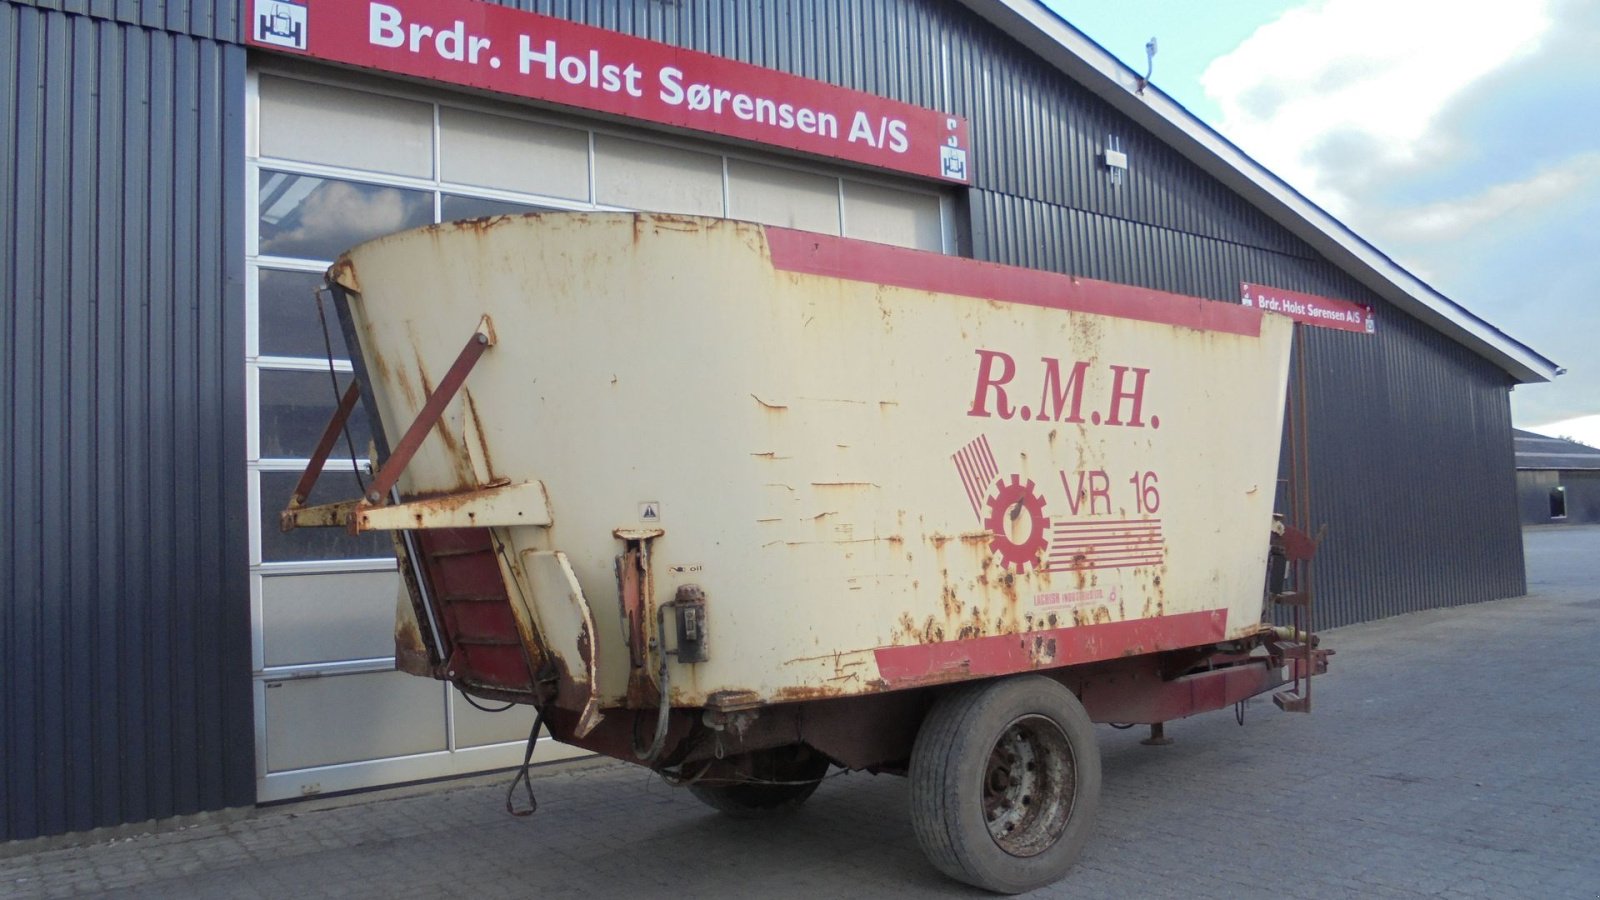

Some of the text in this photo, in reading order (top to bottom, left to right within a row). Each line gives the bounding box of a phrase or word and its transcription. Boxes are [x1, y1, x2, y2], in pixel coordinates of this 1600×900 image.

[369, 2, 908, 153] Brdr. Holst Sørensen A/S
[1258, 295, 1360, 324] Brdr. Holst Sørensen A/S
[967, 349, 1160, 429] R.M.H.
[1059, 470, 1160, 515] VR 16
